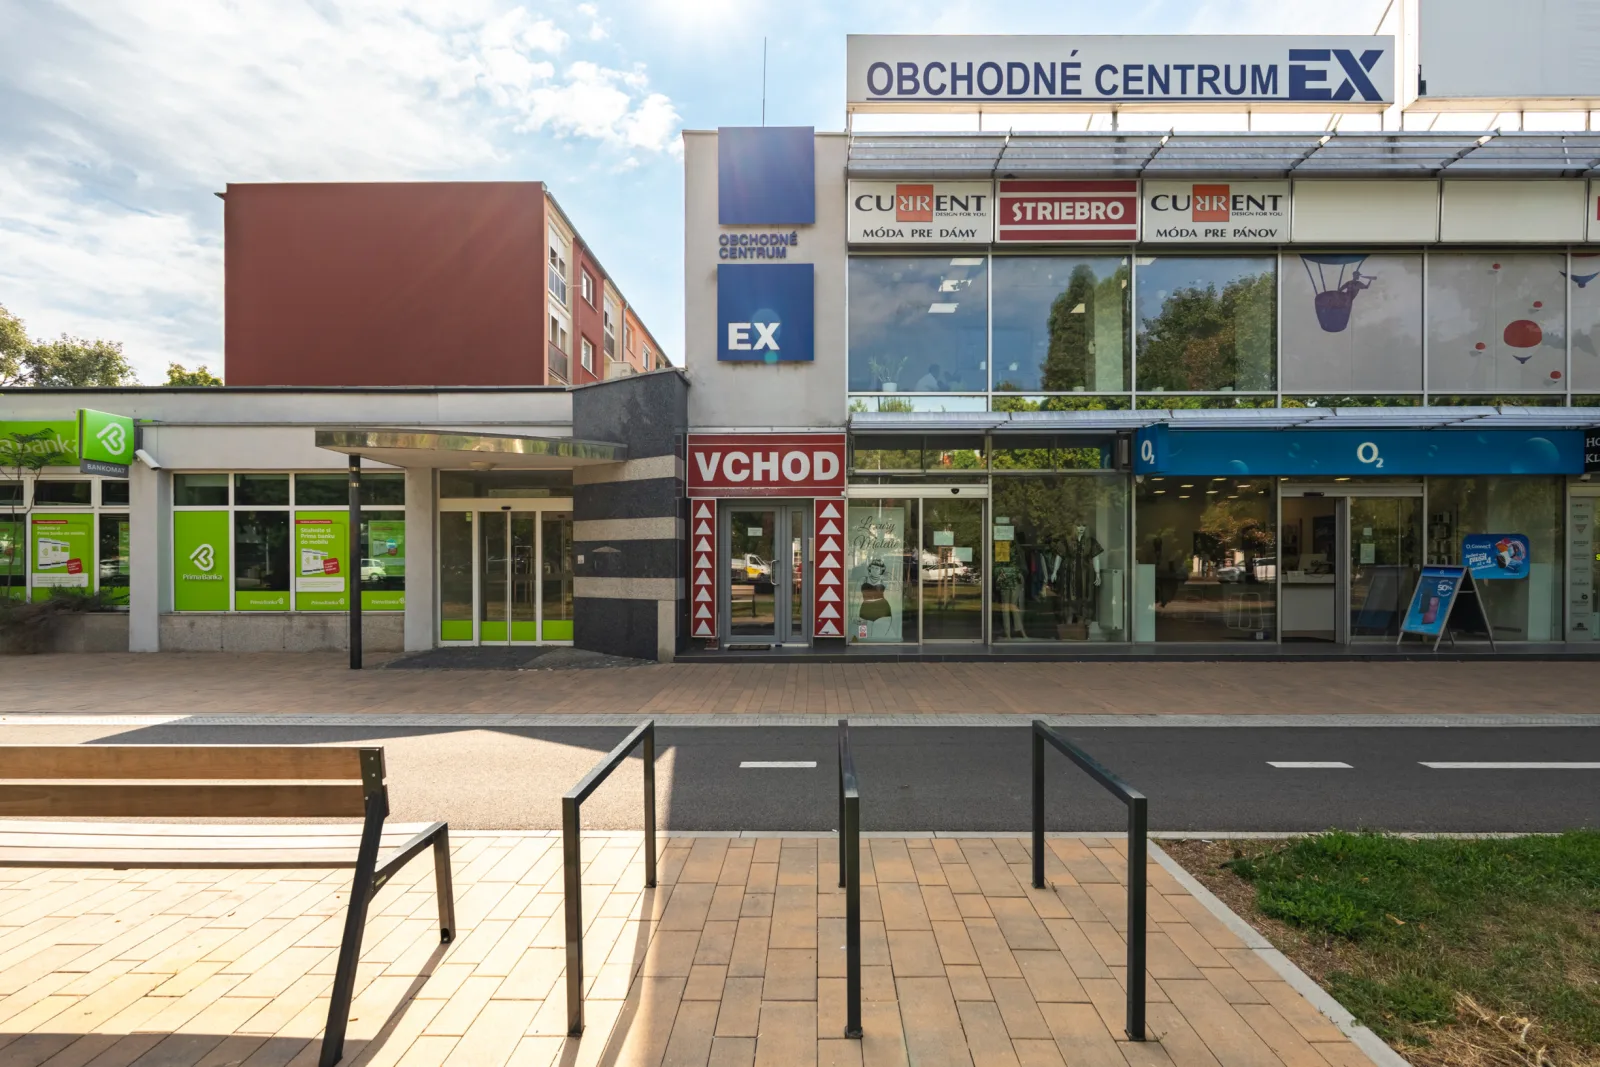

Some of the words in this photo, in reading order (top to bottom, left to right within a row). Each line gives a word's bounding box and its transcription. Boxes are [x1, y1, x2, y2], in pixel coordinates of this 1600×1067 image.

[867, 50, 1082, 96] OBCHODNÉ
[1095, 64, 1278, 96] CENTRUM
[1288, 49, 1385, 102] EX
[1012, 201, 1125, 222] STRIEBRO
[718, 231, 798, 246] OBCHODNÉ
[862, 226, 904, 238] MÓDA
[911, 229, 933, 238] PRE
[939, 226, 977, 238] DÁMY
[1156, 226, 1198, 238] MÓDA
[1204, 228, 1227, 238] PRE
[1233, 226, 1277, 238] PÁNOV
[718, 247, 787, 259] CENTRUM
[728, 322, 780, 350] EX
[1141, 439, 1155, 465] O2
[1356, 441, 1384, 468] O2
[87, 463, 126, 474] BANKOMAT
[694, 451, 840, 482] VCHOD
